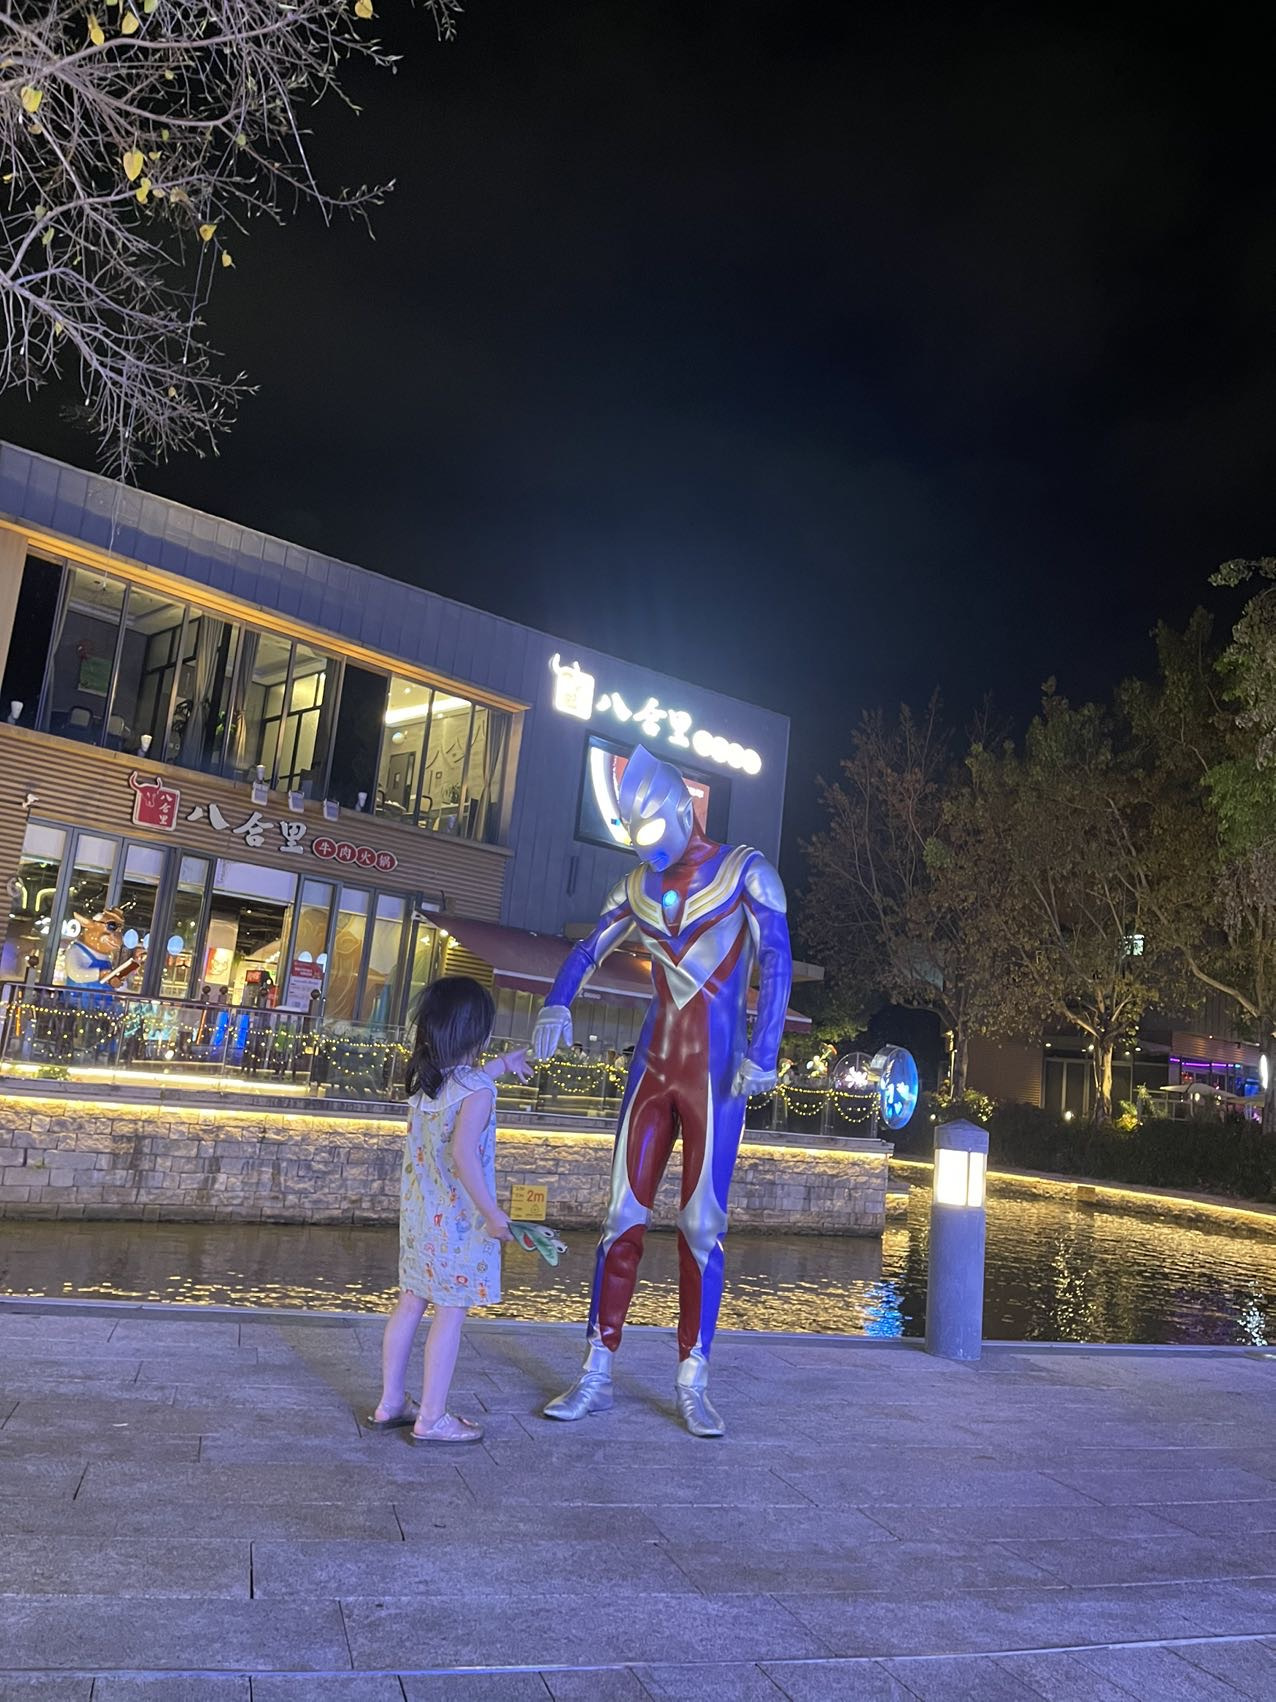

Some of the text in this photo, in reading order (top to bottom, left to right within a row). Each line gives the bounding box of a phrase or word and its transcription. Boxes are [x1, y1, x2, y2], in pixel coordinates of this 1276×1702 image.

[159, 794, 173, 825] 八合里
[186, 803, 307, 854] 八合里
[319, 841, 392, 869] 牛肉火锅
[527, 1190, 545, 1202] 2m
